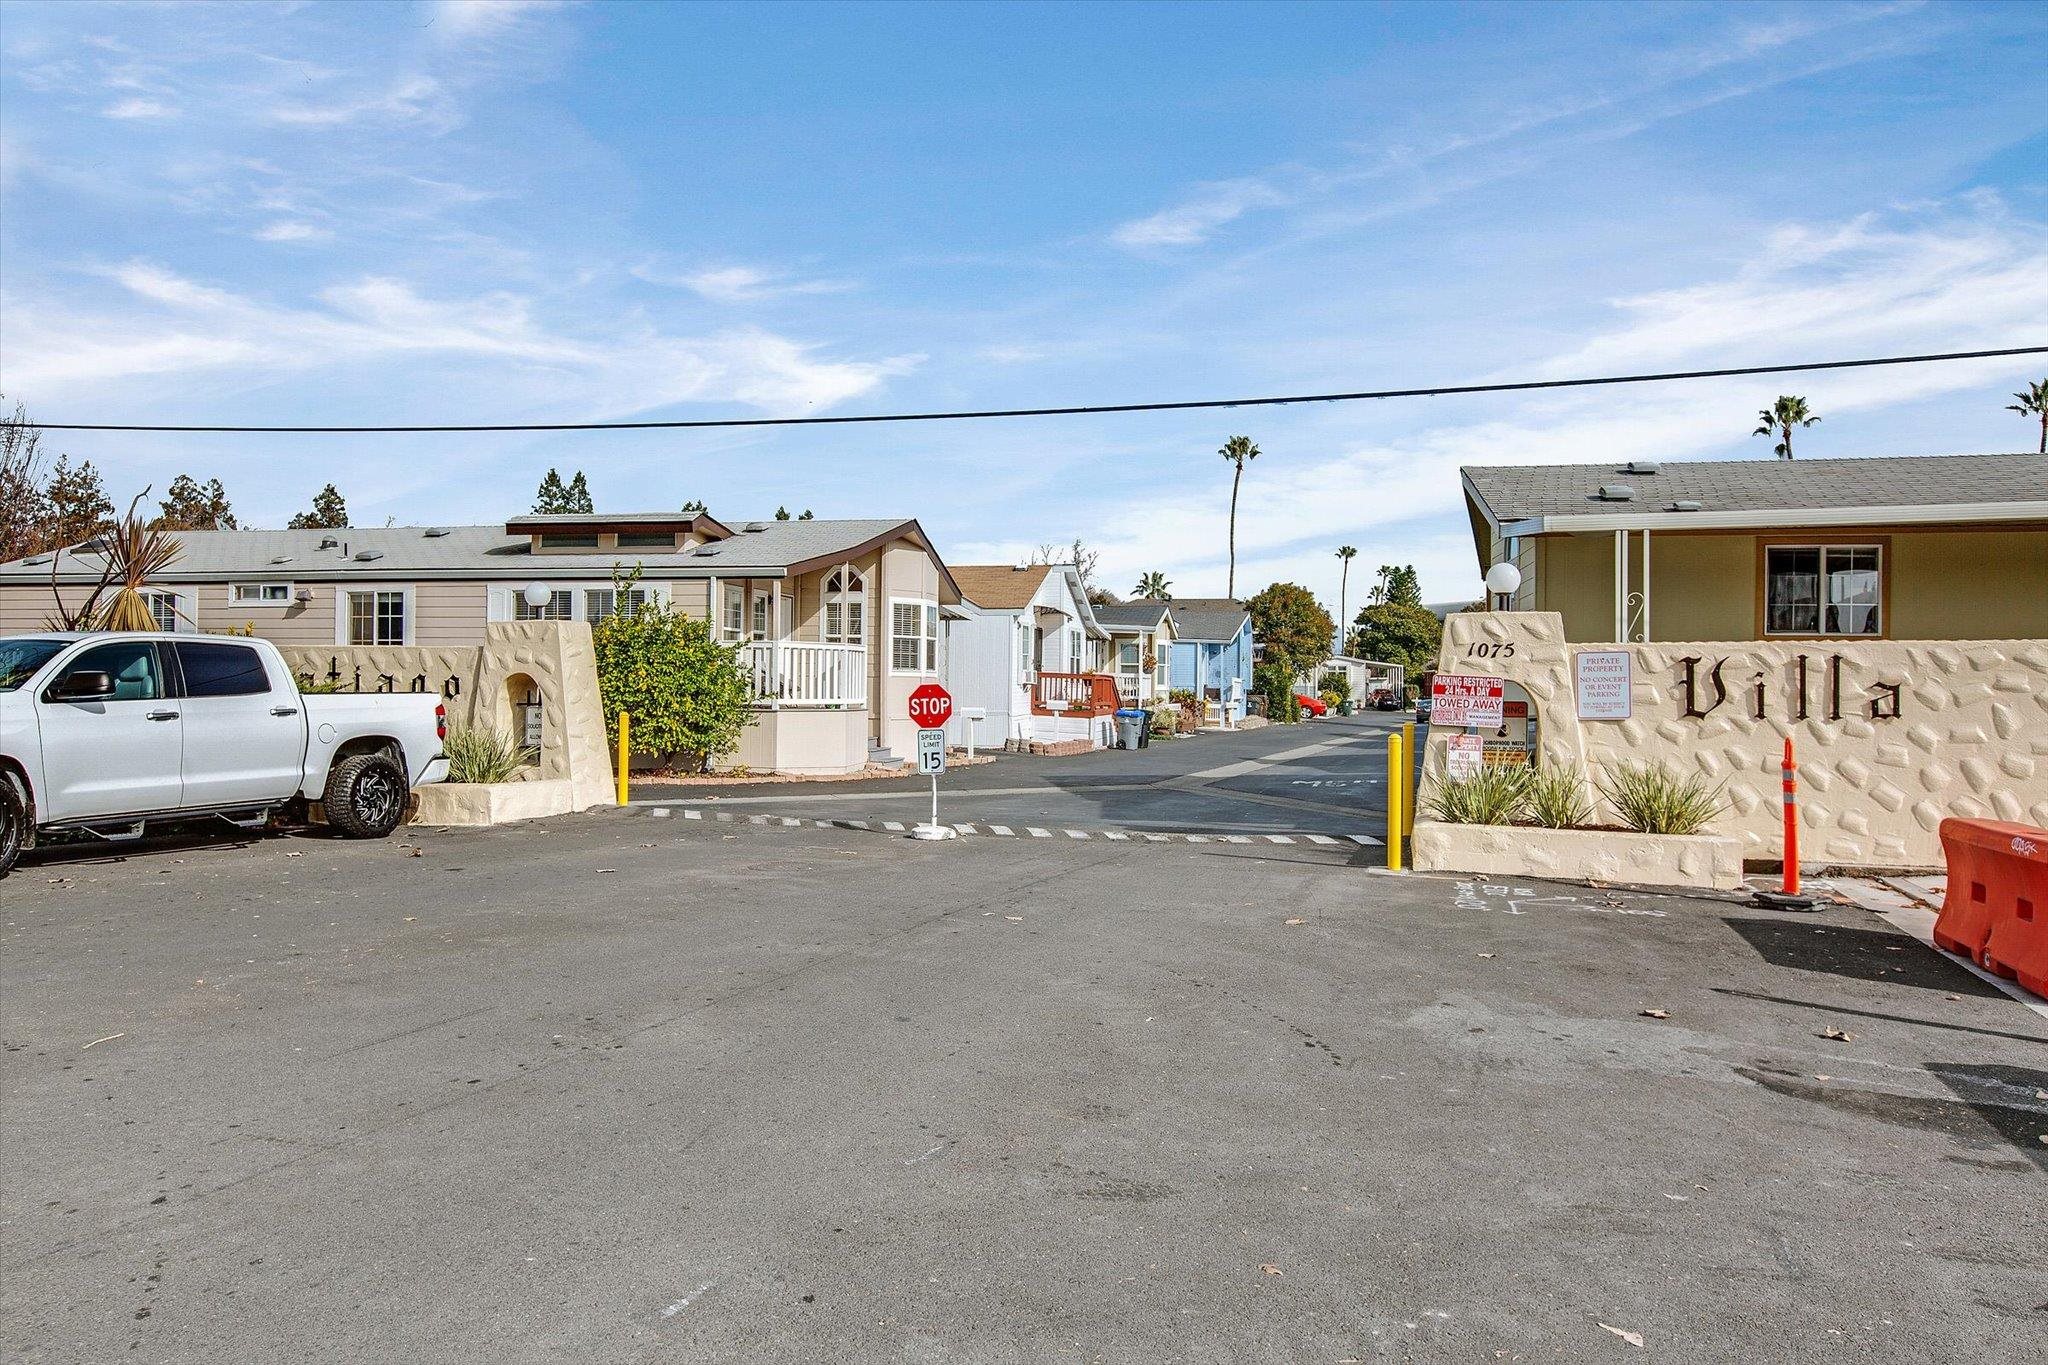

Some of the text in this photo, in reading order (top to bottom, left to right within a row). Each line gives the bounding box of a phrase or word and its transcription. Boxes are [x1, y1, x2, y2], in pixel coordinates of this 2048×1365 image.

[1467, 642, 1515, 658] 1075
[1586, 657, 1620, 665] PRIVATE
[1583, 665, 1624, 673] PROPERTY
[1434, 676, 1503, 689] PARKING RESTRICTED
[1678, 654, 1902, 722] Villa
[1445, 685, 1454, 696] 24
[1470, 687, 1475, 697] A
[1476, 687, 1490, 697] DAY
[911, 697, 951, 716] STOP
[1434, 698, 1502, 710] TOWED AWAY
[1503, 706, 1525, 715] NING
[921, 733, 942, 741] SPEED
[922, 751, 941, 770] 15
[1458, 752, 1470, 760] NO
